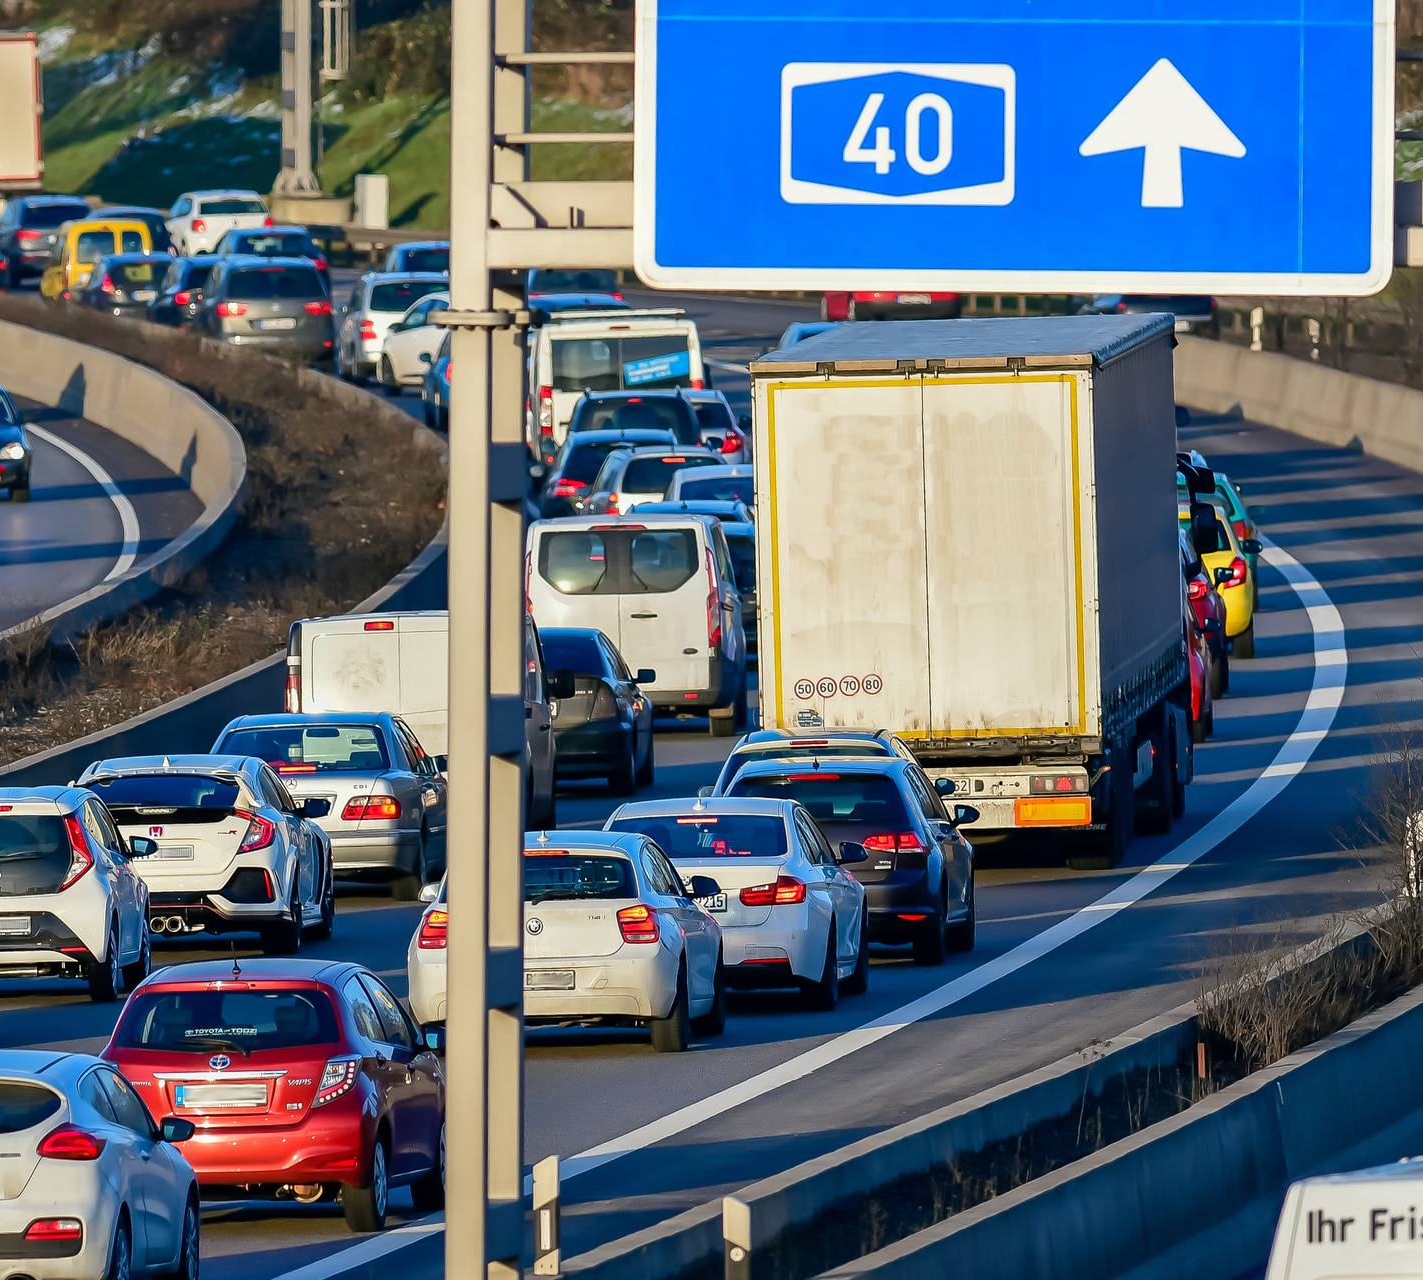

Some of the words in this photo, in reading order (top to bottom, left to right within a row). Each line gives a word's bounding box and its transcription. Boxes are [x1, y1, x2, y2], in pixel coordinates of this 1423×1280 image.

[843, 92, 953, 175] 40
[798, 684, 812, 694] 50
[820, 682, 834, 693] 60
[843, 680, 857, 691] 70
[865, 679, 879, 690] 80
[194, 1027, 224, 1035] TOYOTA
[1307, 1209, 1354, 1244] Ihr
[1369, 1206, 1423, 1241] Fri
